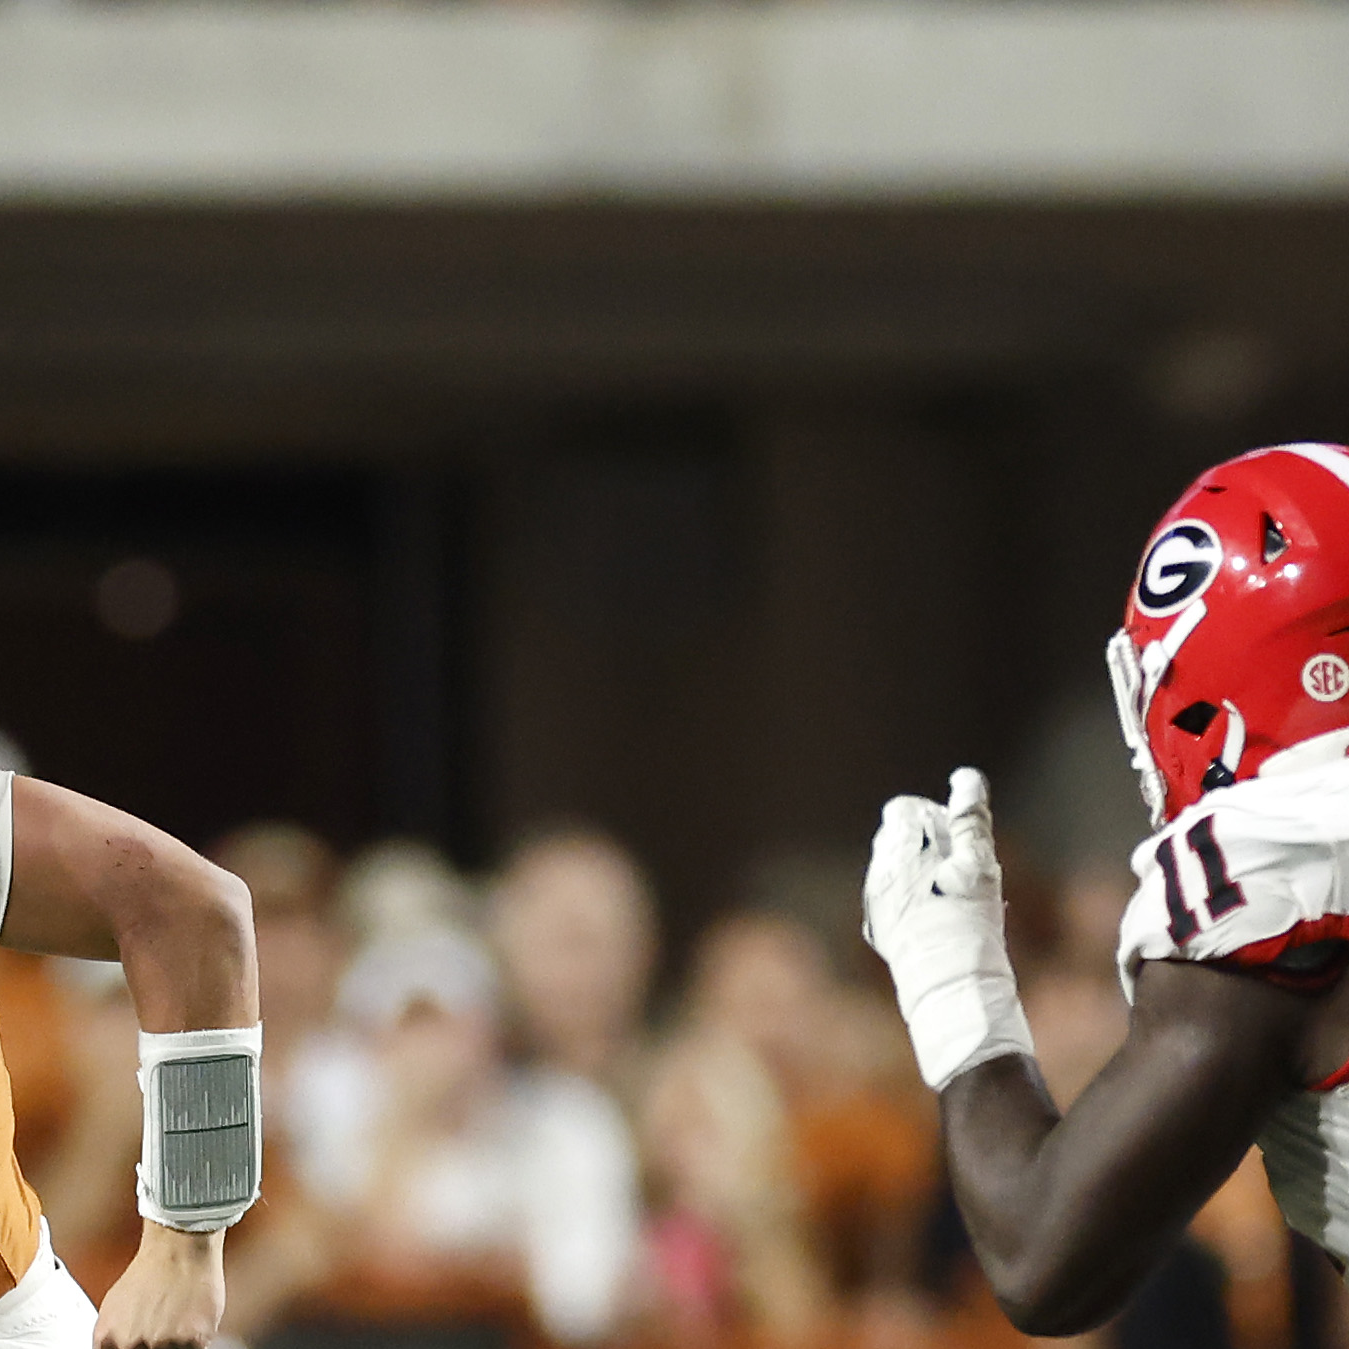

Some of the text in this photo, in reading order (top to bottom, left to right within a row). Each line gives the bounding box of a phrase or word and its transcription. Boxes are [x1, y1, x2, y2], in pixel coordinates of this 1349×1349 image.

[1137, 525, 1214, 610] G
[1307, 659, 1346, 697] SEC
[1154, 812, 1249, 948] 11
